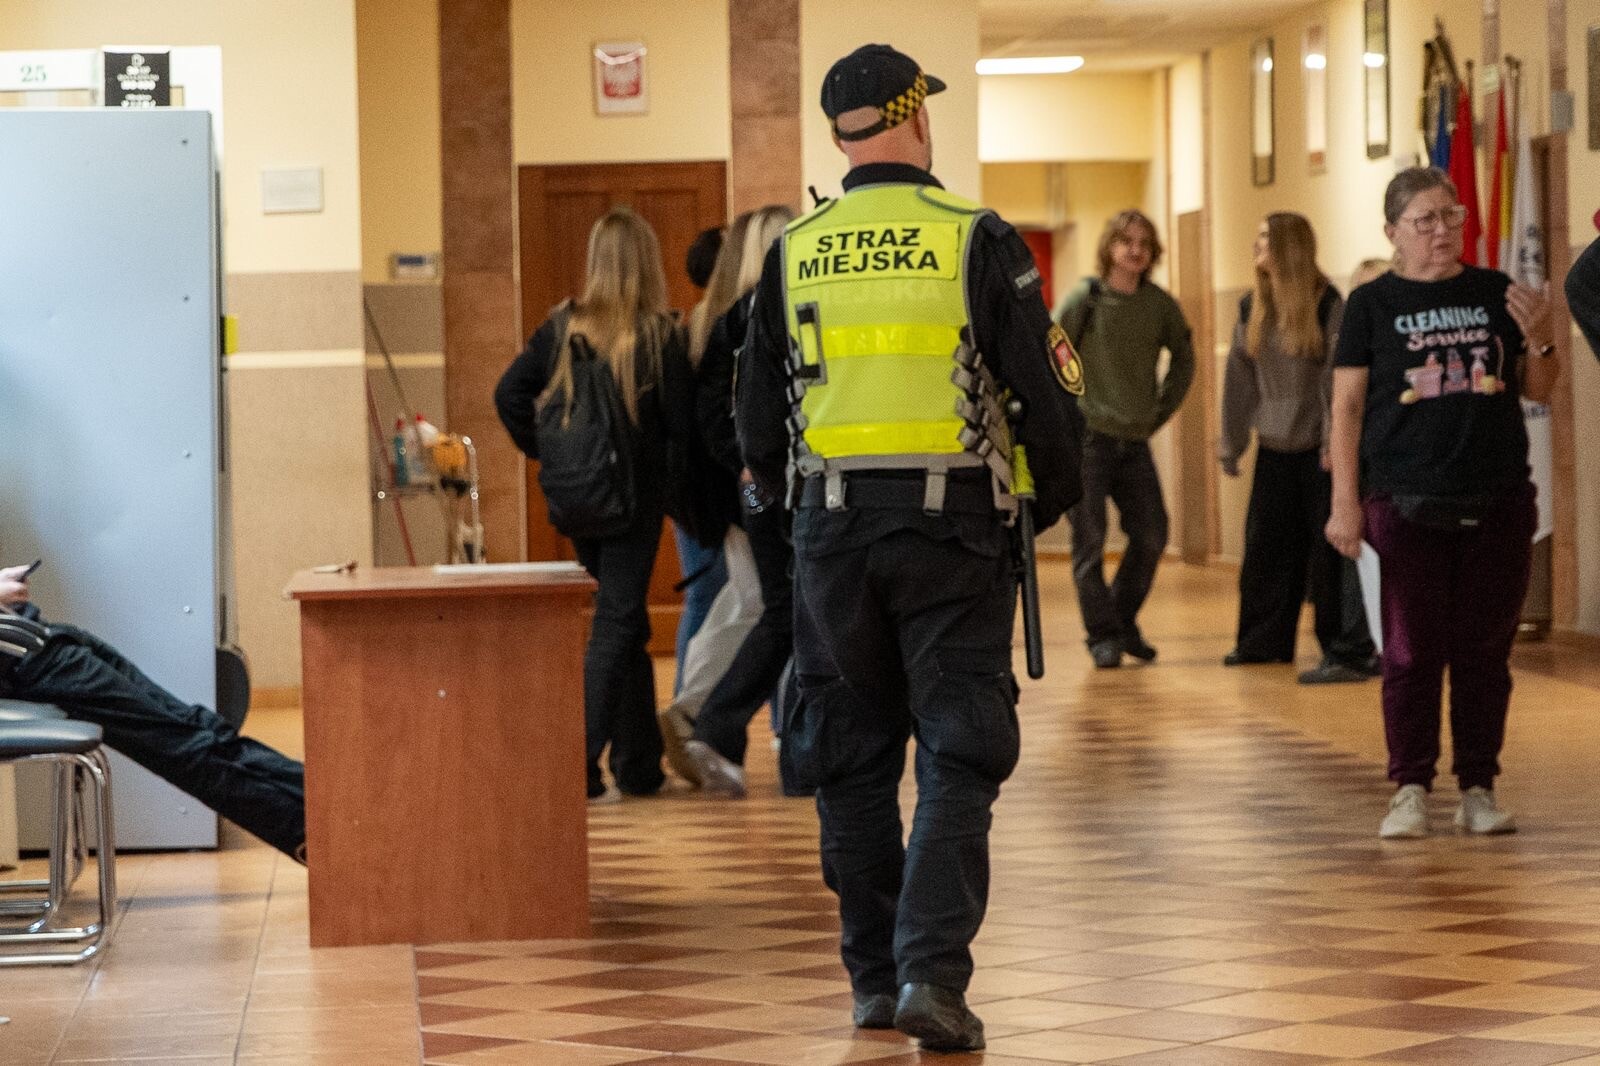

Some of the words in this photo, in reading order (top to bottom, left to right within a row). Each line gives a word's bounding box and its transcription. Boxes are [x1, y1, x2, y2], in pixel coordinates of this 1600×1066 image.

[19, 64, 47, 83] 25
[799, 249, 940, 280] MIEJSKA
[1394, 306, 1490, 335] CLEANING
[1406, 328, 1490, 351] Service
